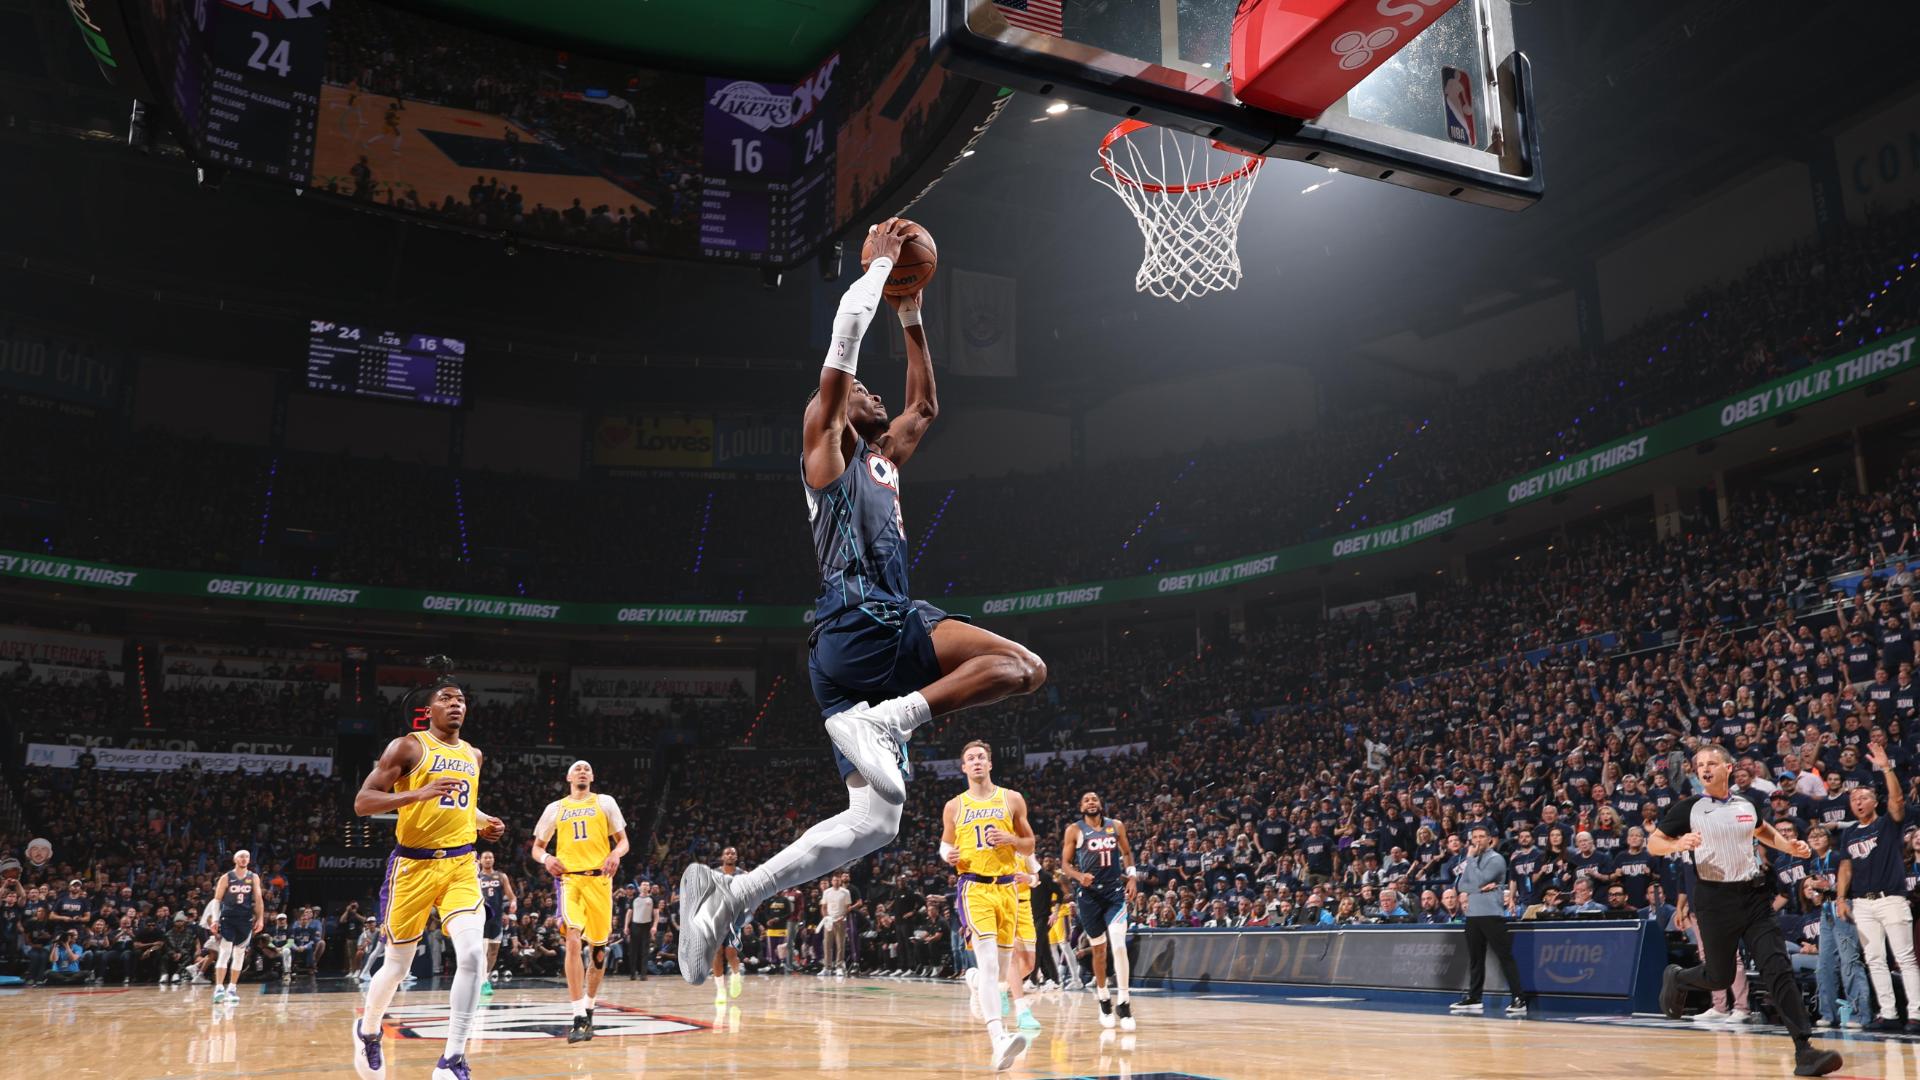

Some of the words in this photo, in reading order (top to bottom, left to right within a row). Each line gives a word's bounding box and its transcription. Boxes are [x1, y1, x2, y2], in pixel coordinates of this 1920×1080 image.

[248, 31, 291, 78] 24
[716, 94, 788, 125] LAKERS
[804, 119, 825, 165] 24
[1450, 125, 1466, 142] NBA
[730, 138, 765, 174] 16
[338, 326, 361, 341] 24
[419, 337, 438, 351] 16
[378, 335, 401, 345] 1:28
[1720, 391, 1773, 427] OBEY
[1775, 369, 1832, 408] YOUR
[1834, 336, 1917, 387] THIRST
[1508, 476, 1546, 504] OBEY
[1547, 460, 1589, 490] YOUR
[1590, 435, 1648, 473] THIRST
[1332, 534, 1370, 556] OBEY
[1372, 526, 1411, 548] YOUR
[1412, 507, 1455, 536] THIRST
[21, 558, 69, 578] YOUR
[73, 565, 138, 587] THIRST
[1158, 575, 1194, 592] OBEY
[1196, 568, 1229, 588] YOUR
[1232, 556, 1278, 579] THIRST
[207, 579, 251, 595] OBEY
[255, 582, 300, 599] YOUR
[302, 587, 360, 604] THIRST
[982, 598, 1017, 614] OBEY
[1019, 593, 1053, 610] YOUR
[1056, 586, 1103, 605] THIRST
[423, 596, 462, 612] OBEY
[466, 598, 506, 614] YOUR
[509, 601, 560, 618] THIRST
[618, 608, 655, 622] OBEY
[657, 608, 695, 622] YOUR
[698, 610, 747, 623] THIRST
[429, 755, 477, 777] LAKERS
[561, 806, 597, 821] LAKERS
[963, 808, 1005, 825] LAKERS
[573, 820, 588, 840] 11
[1087, 836, 1117, 851] OKC
[1099, 850, 1112, 867] 11
[229, 884, 252, 894] OKC
[236, 893, 244, 905] 9
[1538, 939, 1605, 968] prime
